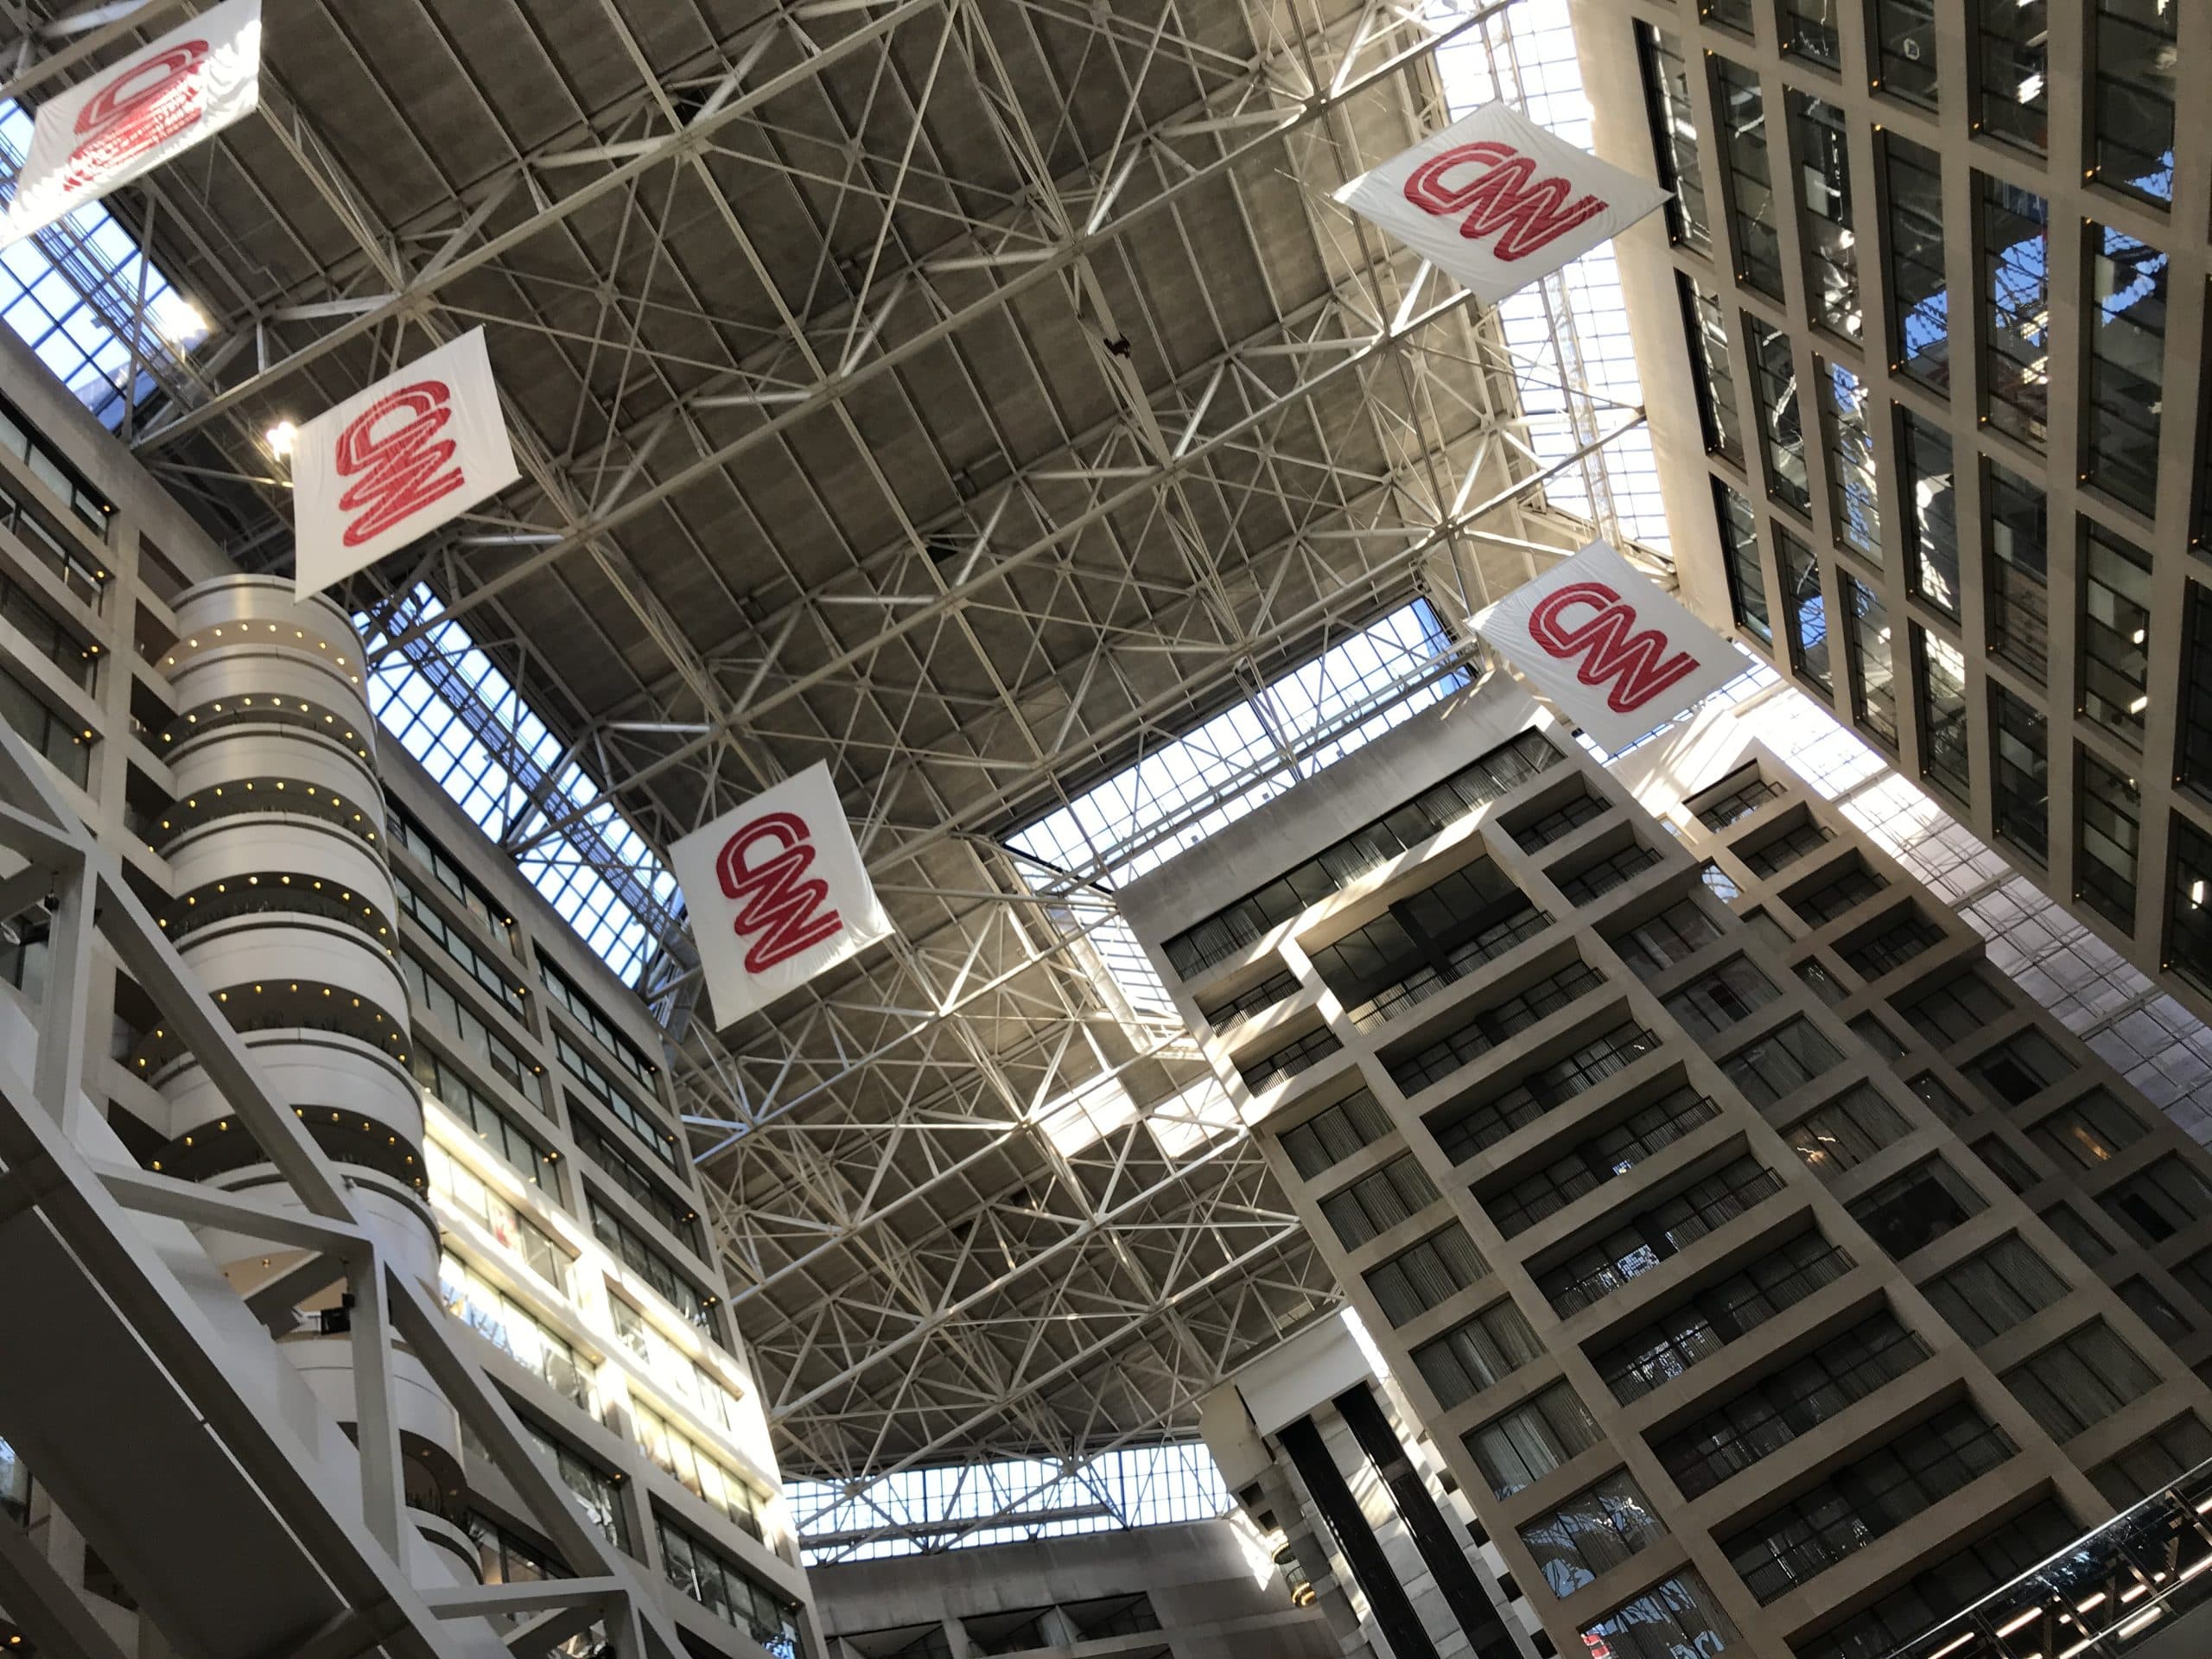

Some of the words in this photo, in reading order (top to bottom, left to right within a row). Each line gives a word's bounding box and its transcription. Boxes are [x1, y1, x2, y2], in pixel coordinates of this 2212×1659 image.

[1403, 141, 1609, 262] CNN
[334, 380, 466, 547] CNN
[1528, 582, 1700, 714] CNN
[715, 812, 844, 974] CNN
